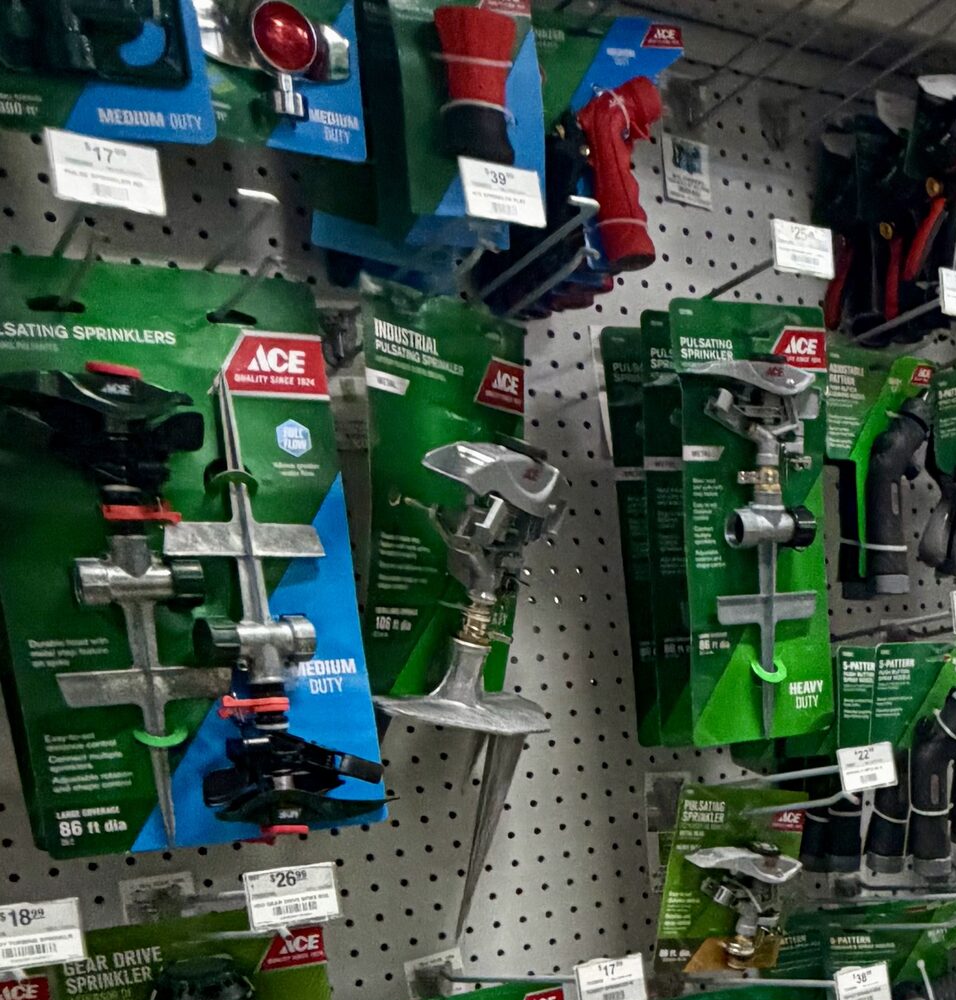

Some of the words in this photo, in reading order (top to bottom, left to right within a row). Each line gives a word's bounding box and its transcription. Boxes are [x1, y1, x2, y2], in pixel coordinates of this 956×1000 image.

[97, 107, 165, 128] MEDIUM
[169, 112, 202, 131] DUTY
[308, 107, 359, 131] MEDIUM
[0, 323, 68, 341] SATING
[73, 326, 176, 345] SPRINKLERS
[374, 317, 439, 357] INDUSTRIAL
[680, 336, 733, 350] PULSATING
[785, 335, 818, 355] ACE
[247, 344, 306, 375] ACE
[680, 349, 734, 361] SPRINKLER
[234, 374, 268, 385] QUALITY
[270, 375, 294, 385] SINCE
[492, 369, 520, 395] ACE
[310, 677, 344, 694] DUTY
[789, 680, 824, 696] HEAVY
[795, 696, 819, 710] DUTY
[683, 799, 726, 813] PULSATING
[681, 811, 725, 824] SPRINKLER
[778, 812, 802, 824] ACE
[59, 820, 83, 837] 86
[87, 820, 101, 834] ft
[104, 818, 128, 833] dia
[280, 933, 320, 955] ACE
[64, 956, 108, 977] GEAR
[113, 946, 164, 969] DRIVE
[66, 966, 154, 995] SPRINKLER
